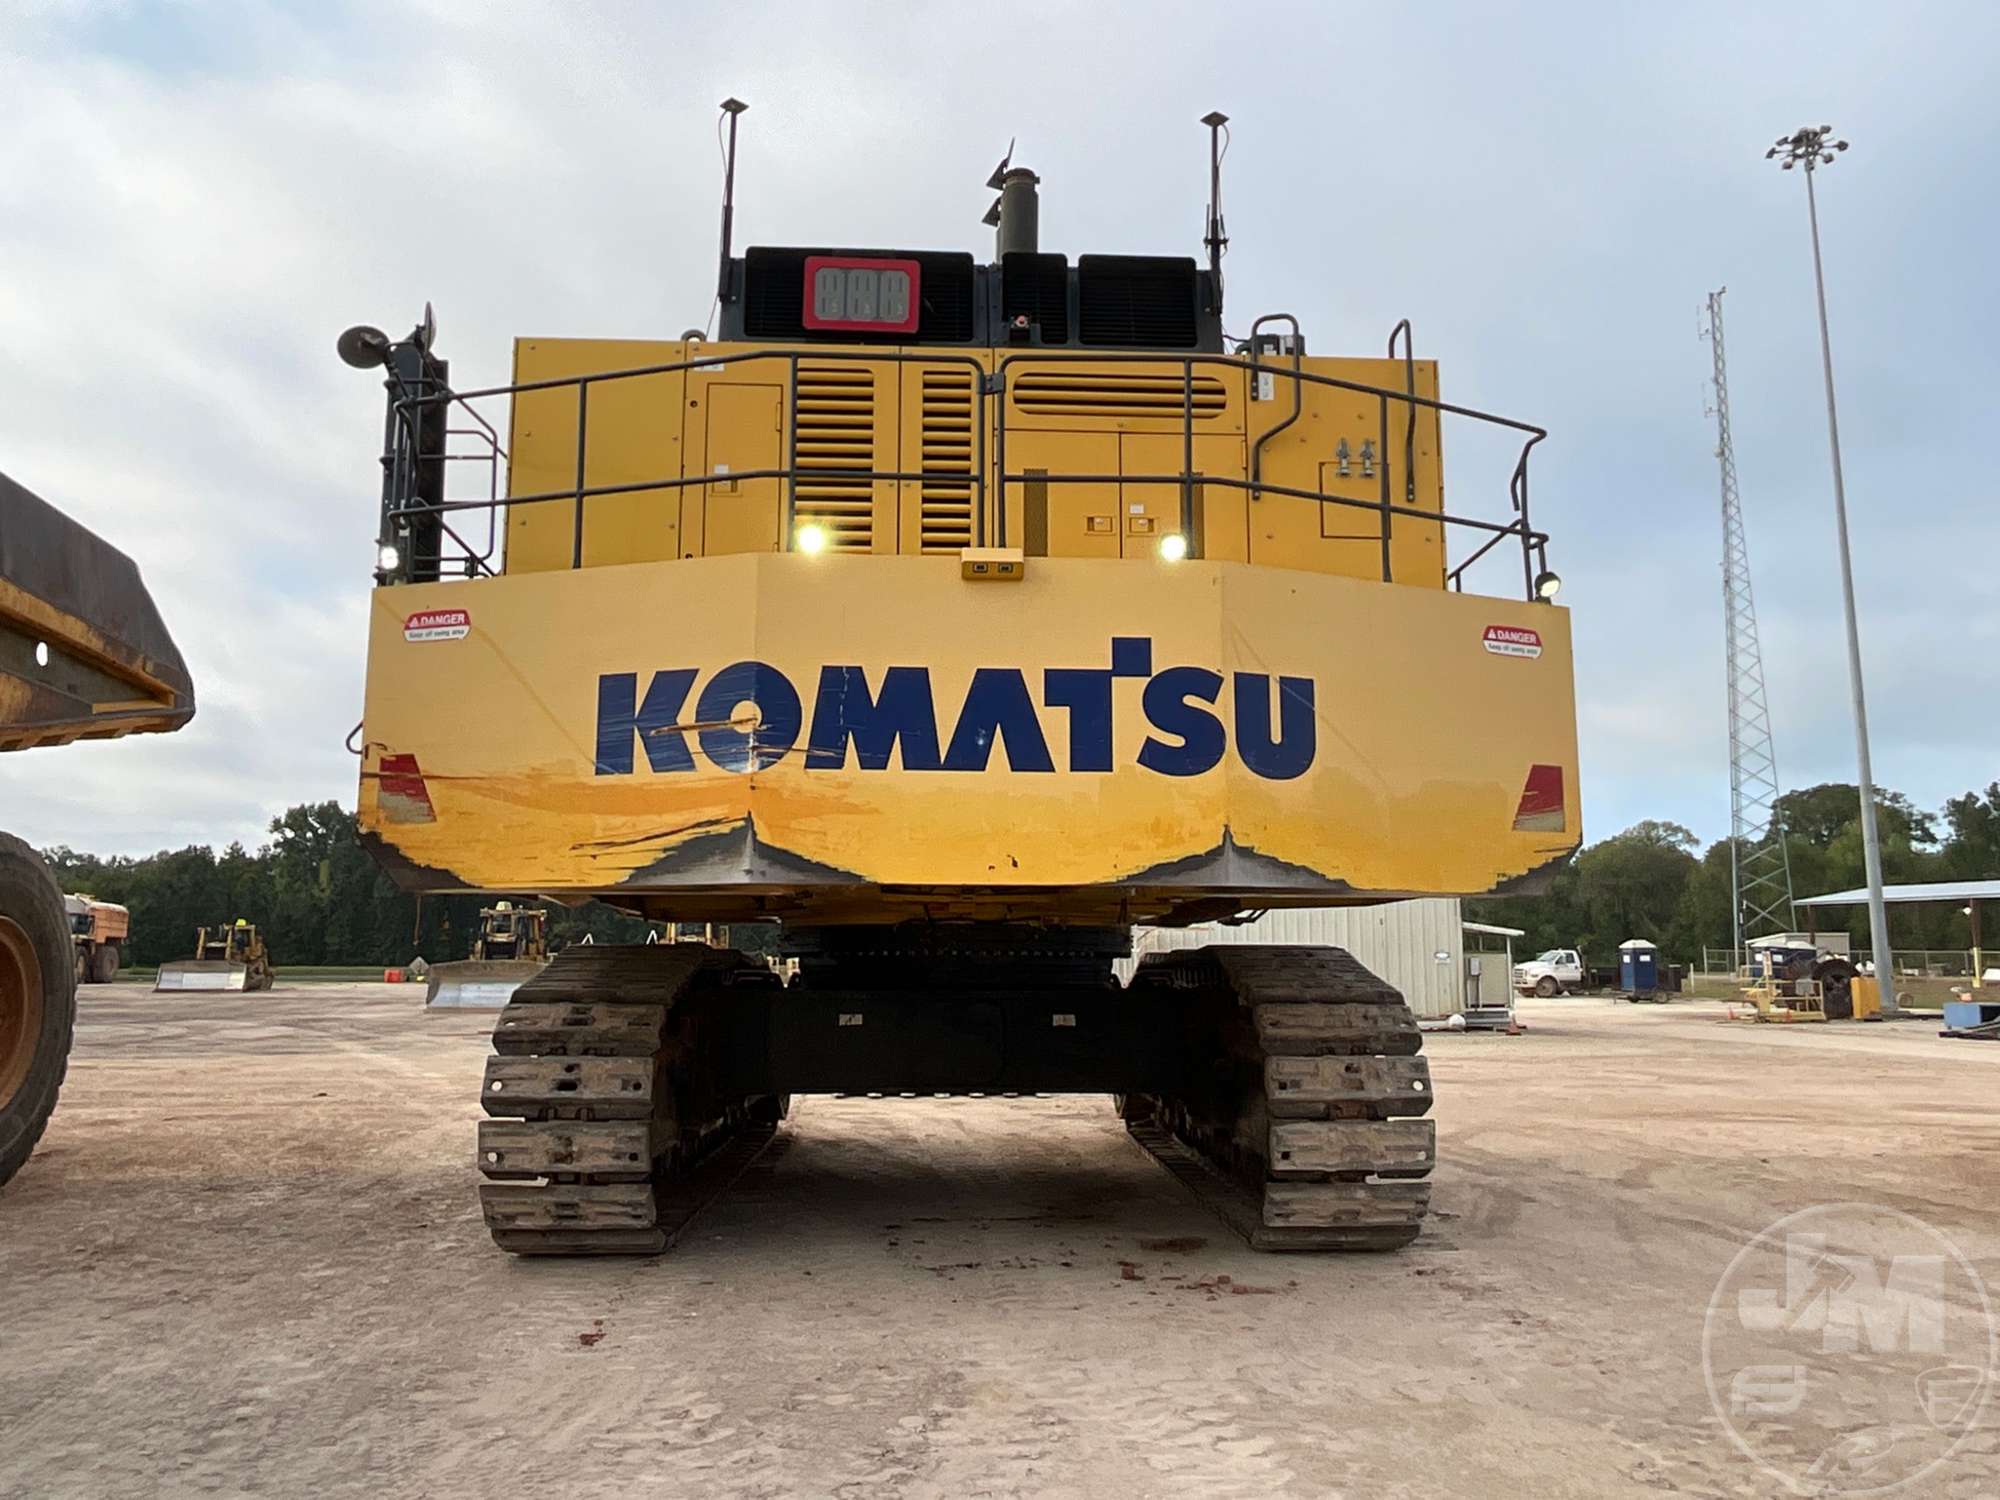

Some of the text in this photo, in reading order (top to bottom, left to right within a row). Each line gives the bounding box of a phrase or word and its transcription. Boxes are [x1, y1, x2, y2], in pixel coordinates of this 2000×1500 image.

[420, 613, 465, 626] DANGER
[1496, 630, 1537, 644] DANGER
[595, 636, 1317, 781] KOMATSU
